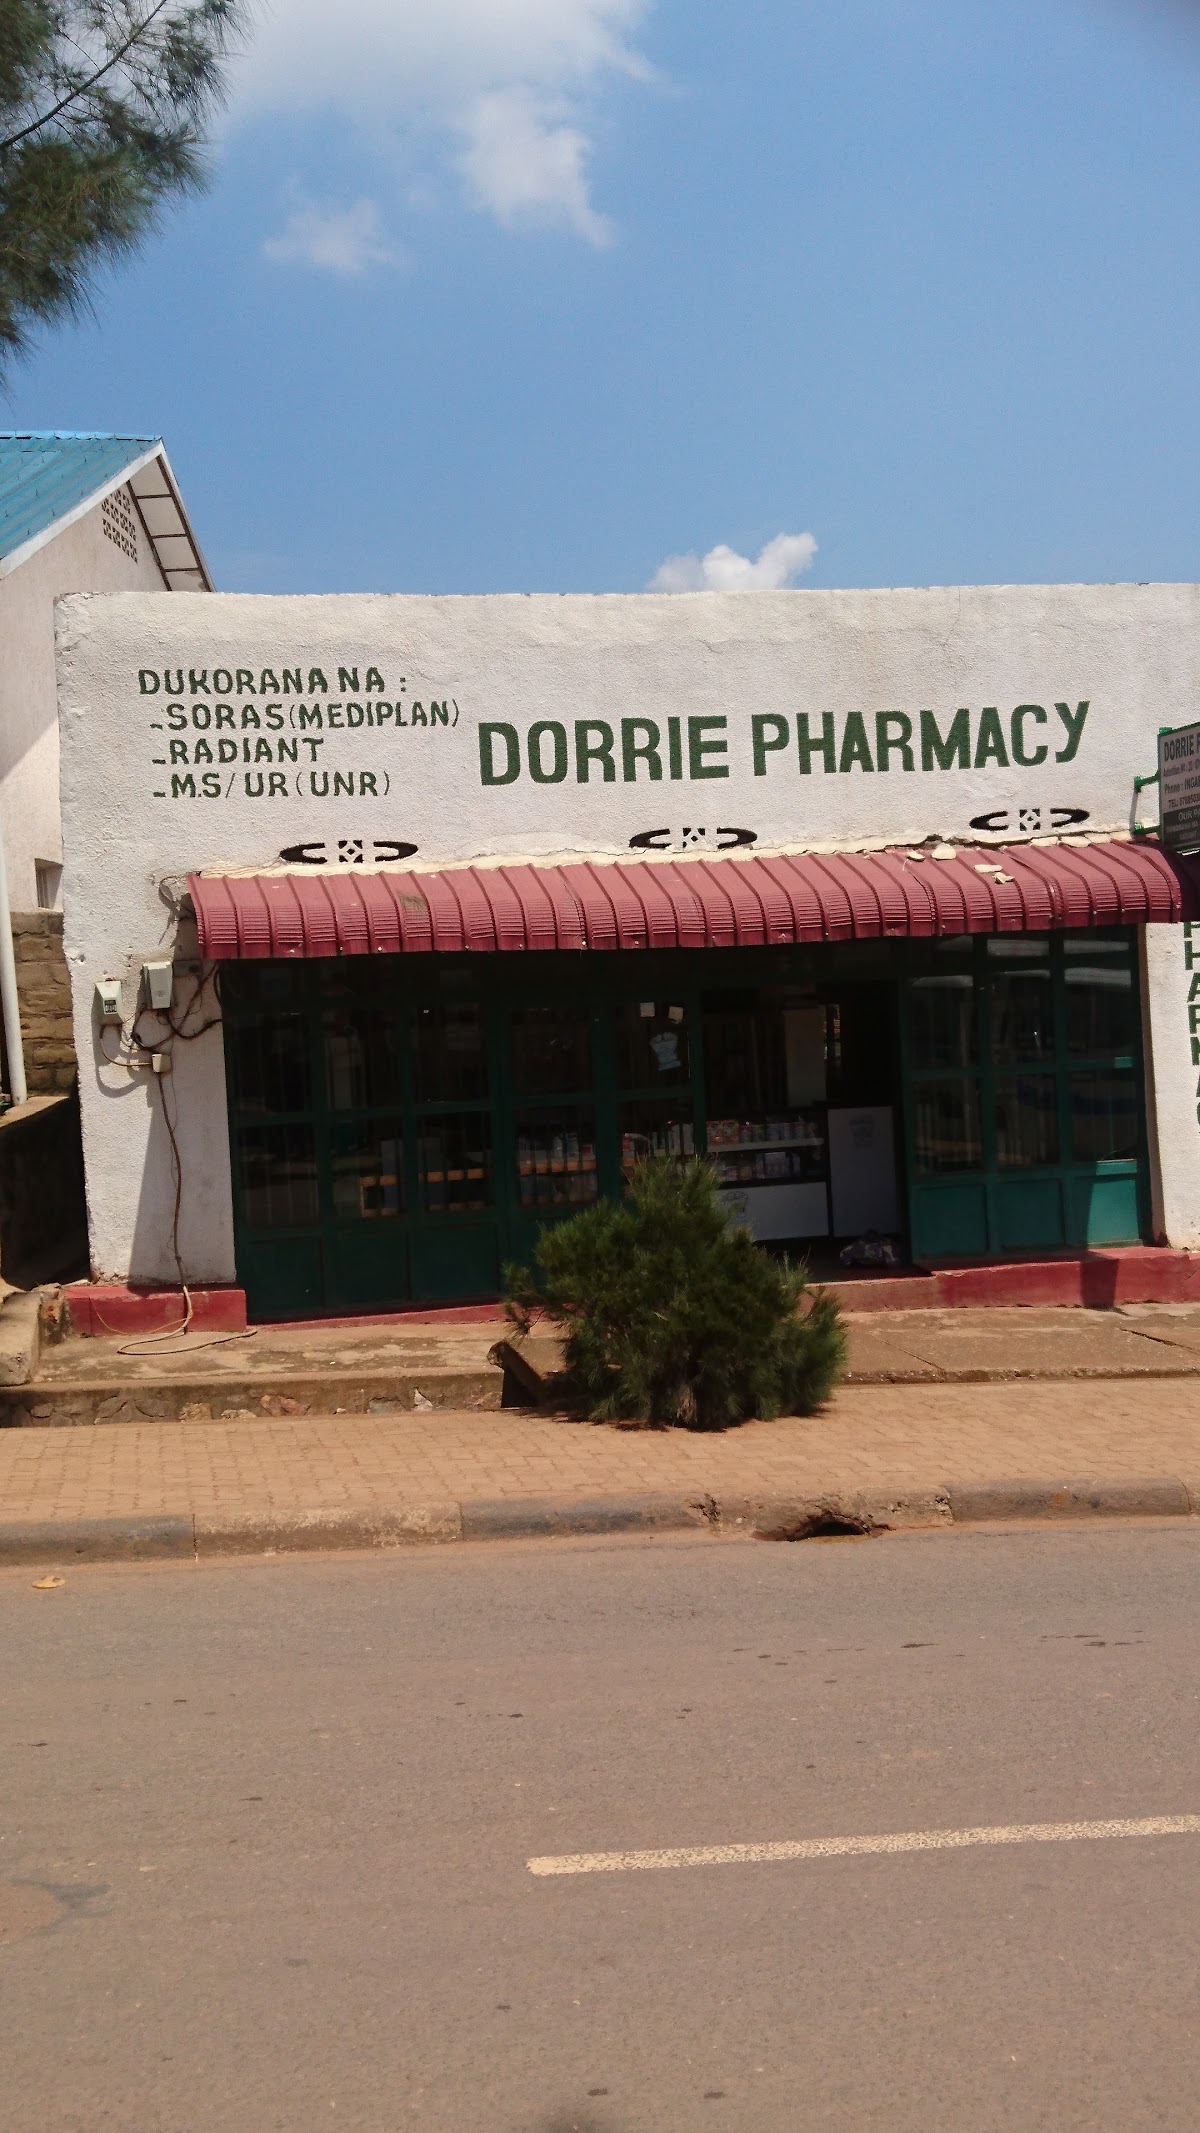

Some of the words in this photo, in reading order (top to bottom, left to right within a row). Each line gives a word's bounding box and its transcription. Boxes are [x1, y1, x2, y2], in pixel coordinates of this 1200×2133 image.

[138, 667, 328, 695] DUKORANA
[338, 666, 385, 693] NA
[478, 714, 730, 786] DORRIE
[752, 701, 1090, 776] PHARMACY
[1164, 734, 1195, 762] DORRIE
